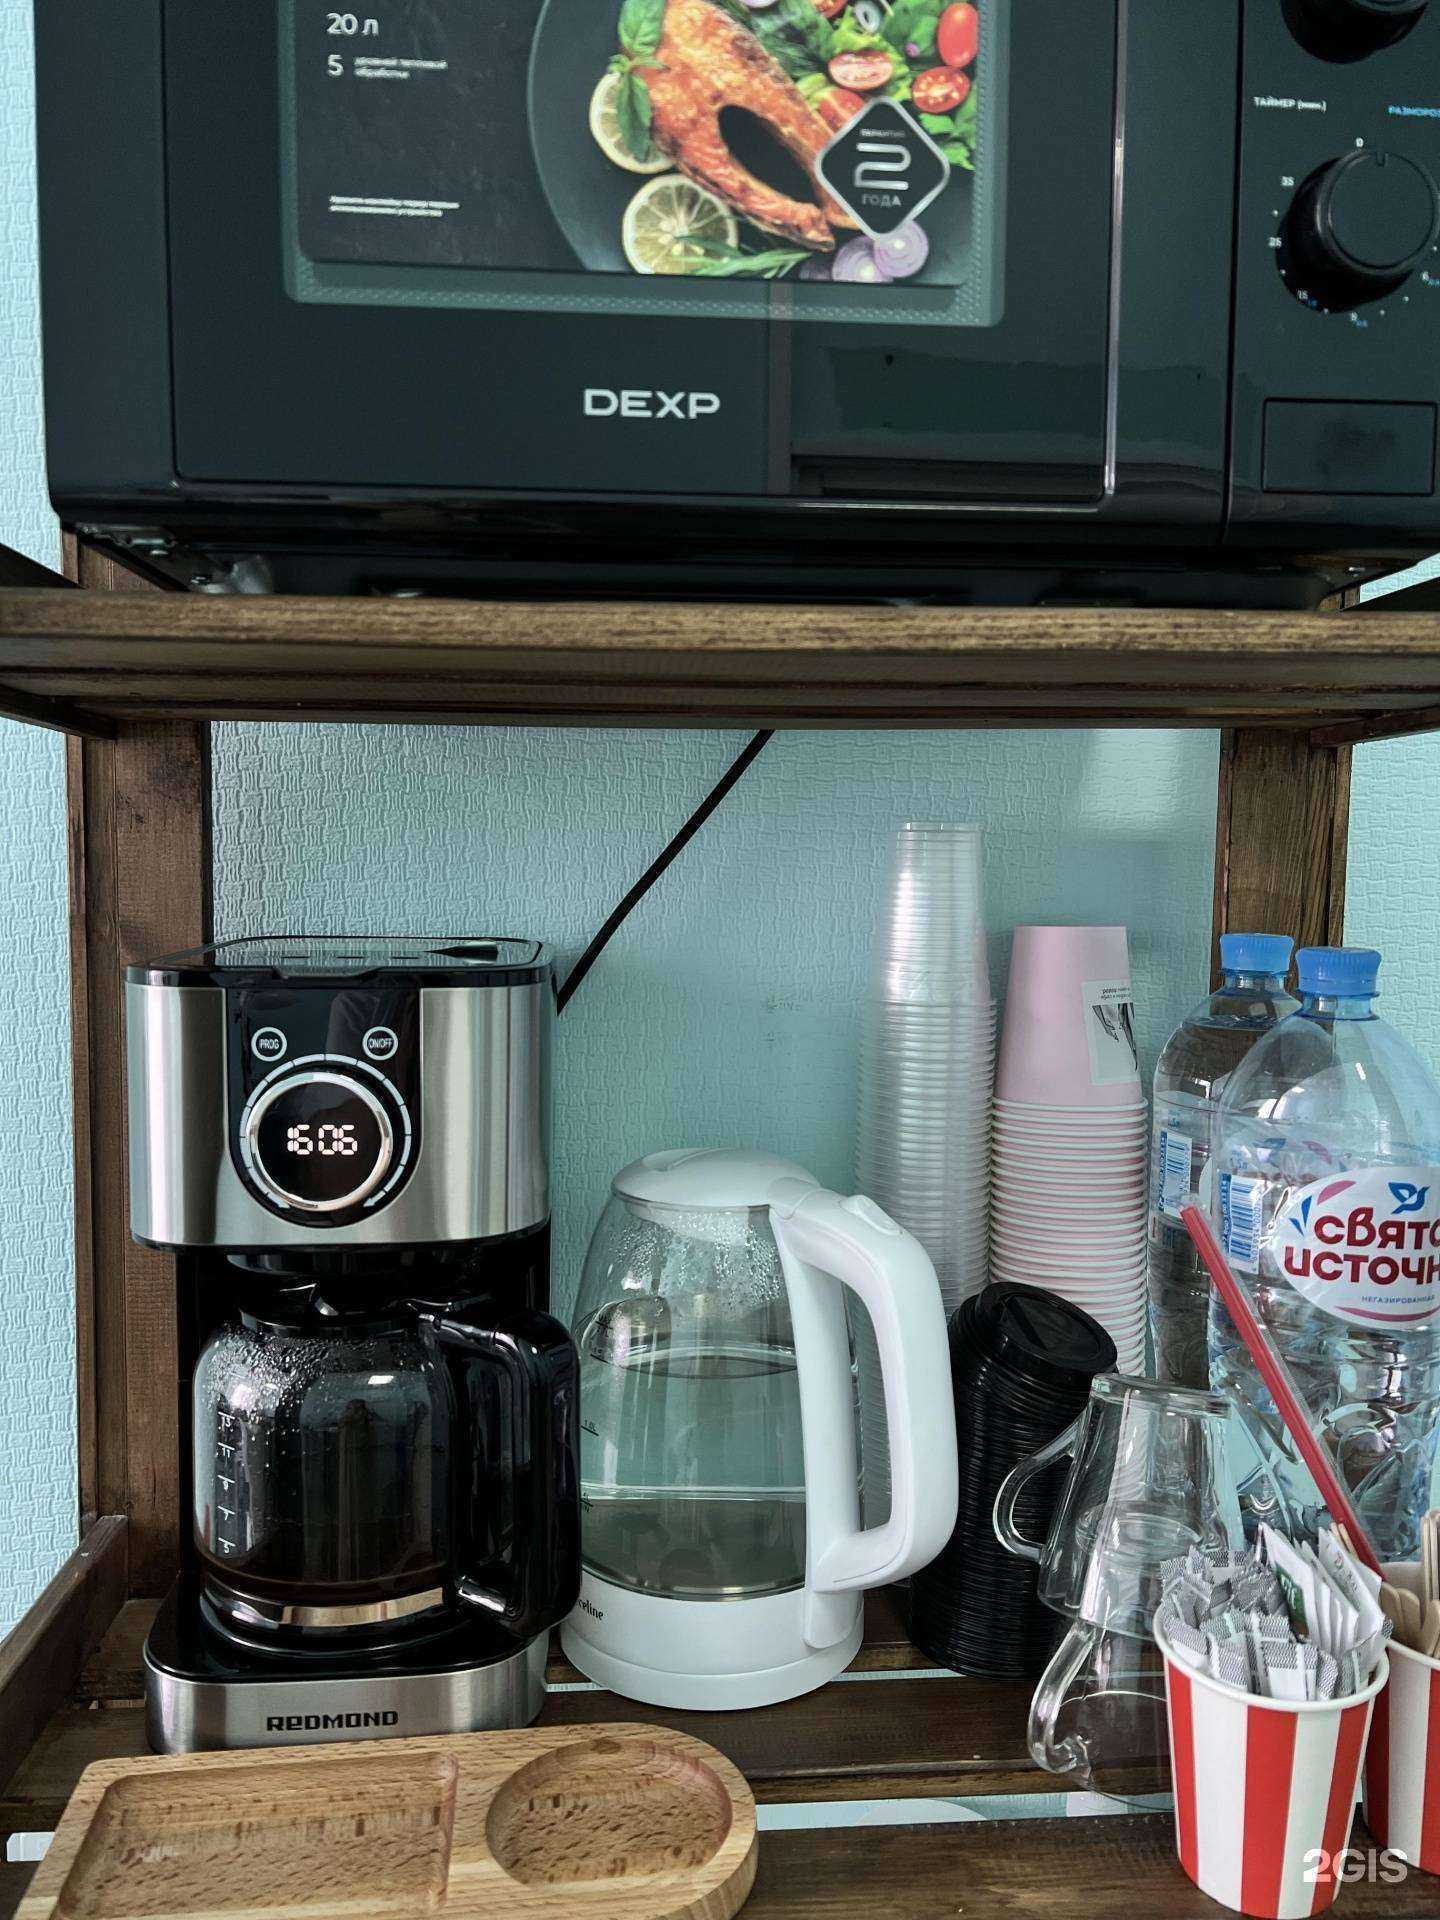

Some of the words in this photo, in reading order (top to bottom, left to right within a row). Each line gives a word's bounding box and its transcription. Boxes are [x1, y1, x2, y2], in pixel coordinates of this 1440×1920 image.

[326, 12, 358, 36] 20
[362, 17, 379, 37] л
[326, 54, 345, 77] 5
[855, 142, 912, 191] 2
[861, 193, 902, 208] ГОДА
[584, 388, 721, 420] DEXP
[259, 1038, 280, 1050] PROG
[368, 1037, 393, 1050] ON/OFF
[266, 1710, 399, 1732] REDMOND
